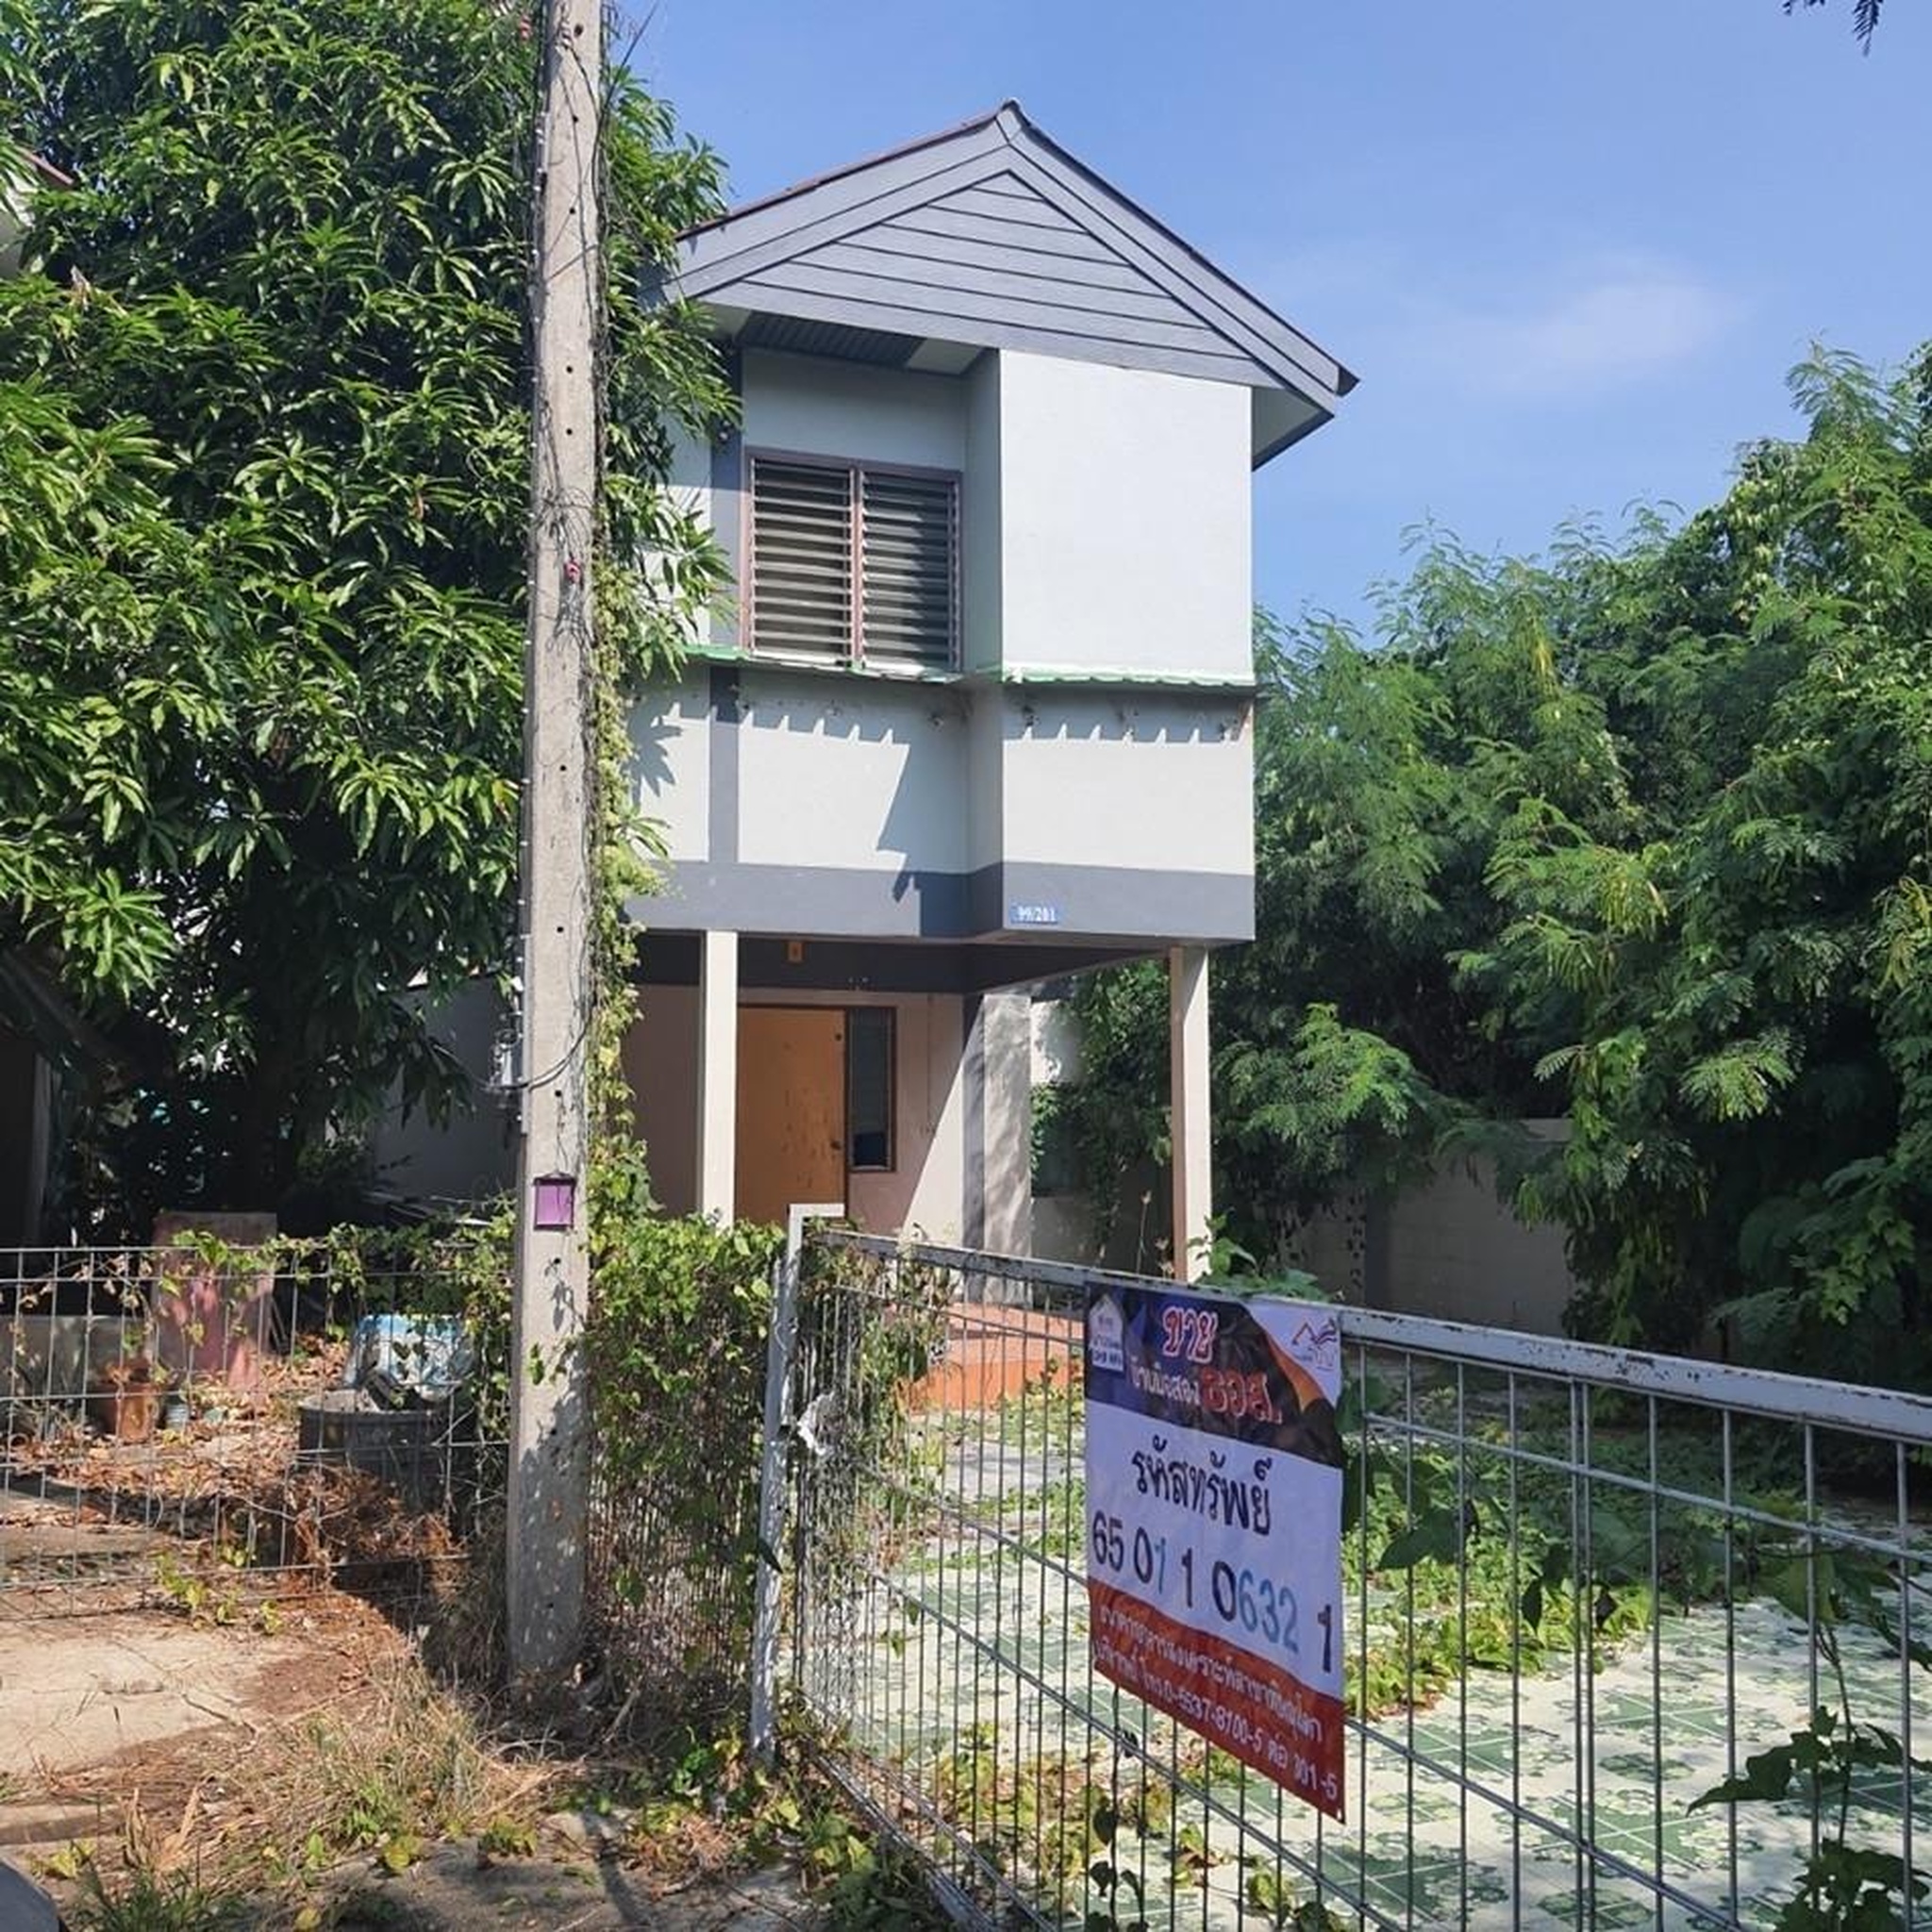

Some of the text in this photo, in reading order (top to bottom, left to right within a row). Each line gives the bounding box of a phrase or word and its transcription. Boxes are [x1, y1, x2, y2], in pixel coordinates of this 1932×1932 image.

[1162, 1306, 1218, 1363] ขาย
[1132, 1435, 1274, 1536] รหัสทรัพย์
[1092, 1510, 1124, 1573] 65
